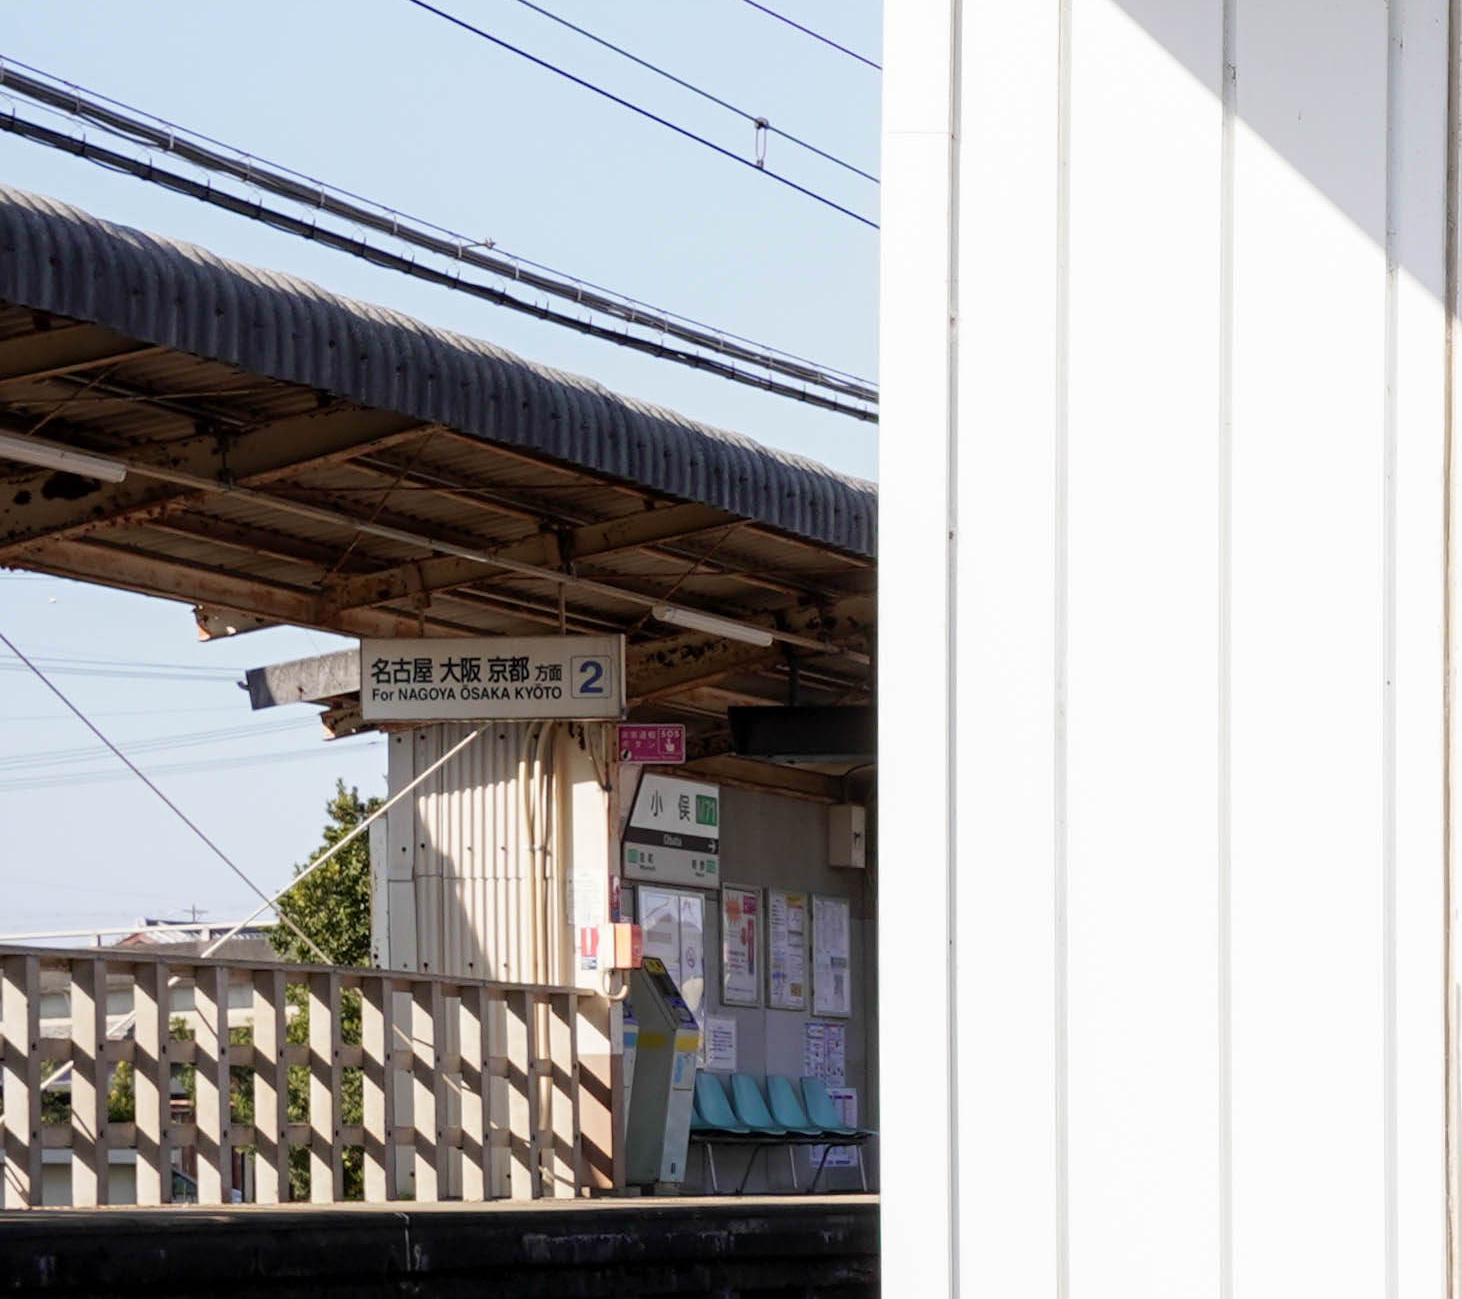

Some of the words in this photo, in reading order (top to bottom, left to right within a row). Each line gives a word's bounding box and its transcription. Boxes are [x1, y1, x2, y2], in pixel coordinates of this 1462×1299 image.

[371, 657, 433, 684] 名古屋
[439, 657, 481, 684] 大阪
[487, 656, 530, 683] 京都
[535, 663, 562, 682] 方面
[578, 660, 604, 694] 2
[372, 688, 394, 701] For
[398, 687, 454, 701] NAGOYA
[460, 684, 510, 701] ŌSAKA
[515, 683, 562, 700] KYŌTO
